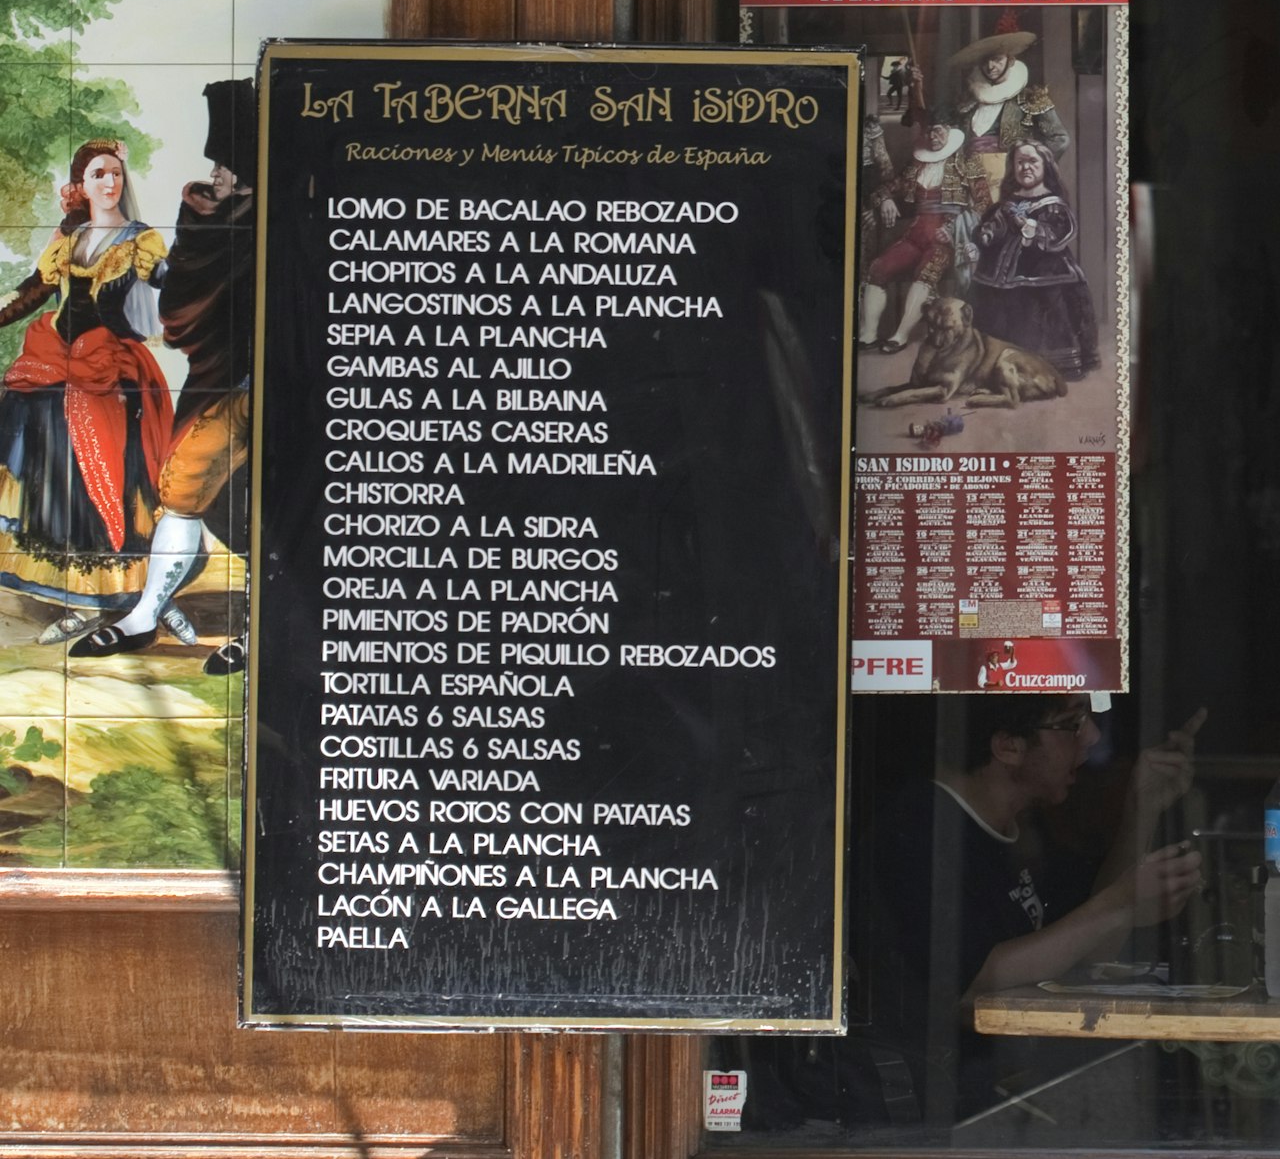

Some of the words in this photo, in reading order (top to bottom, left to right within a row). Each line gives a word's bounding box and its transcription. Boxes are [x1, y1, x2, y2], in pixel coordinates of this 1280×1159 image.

[300, 82, 354, 123] LA
[373, 81, 568, 123] TABERNA
[589, 84, 673, 126] SAN
[345, 142, 458, 163] Raciones
[459, 147, 475, 166] y
[481, 143, 558, 164] Menús
[647, 146, 680, 165] de
[683, 146, 773, 170] España
[327, 197, 406, 221] LOMO
[416, 198, 450, 221] DE
[459, 199, 587, 222] BACALAO
[596, 201, 739, 224] REBOZADO
[326, 355, 439, 379] GAMBAS
[447, 357, 481, 379] AL
[489, 357, 572, 381] AJILLO
[325, 418, 482, 443] CROQUETAS
[490, 420, 609, 444] CASERAS
[896, 457, 954, 473] ISIDRO
[958, 457, 998, 473] 2011
[861, 482, 882, 491] CON
[884, 482, 942, 491] PICADORES
[950, 483, 961, 491] DE
[886, 475, 893, 484] 2
[895, 475, 948, 484] CORRIDAS
[950, 475, 962, 484] DE
[965, 475, 1012, 484] REJONES
[324, 482, 465, 506] CHISTORRA
[322, 546, 458, 570] MORCILLA
[467, 547, 501, 570] DE
[511, 547, 619, 572] BURGOS
[852, 657, 924, 676] PFRE
[1004, 671, 1086, 690] Cruzcampo
[319, 736, 454, 760] COSTILLAS
[463, 737, 479, 760] 6
[487, 738, 581, 761] SALSAS
[319, 767, 420, 791] FRITURA
[429, 769, 540, 792] VARIADA
[317, 926, 409, 949] PAELLA
